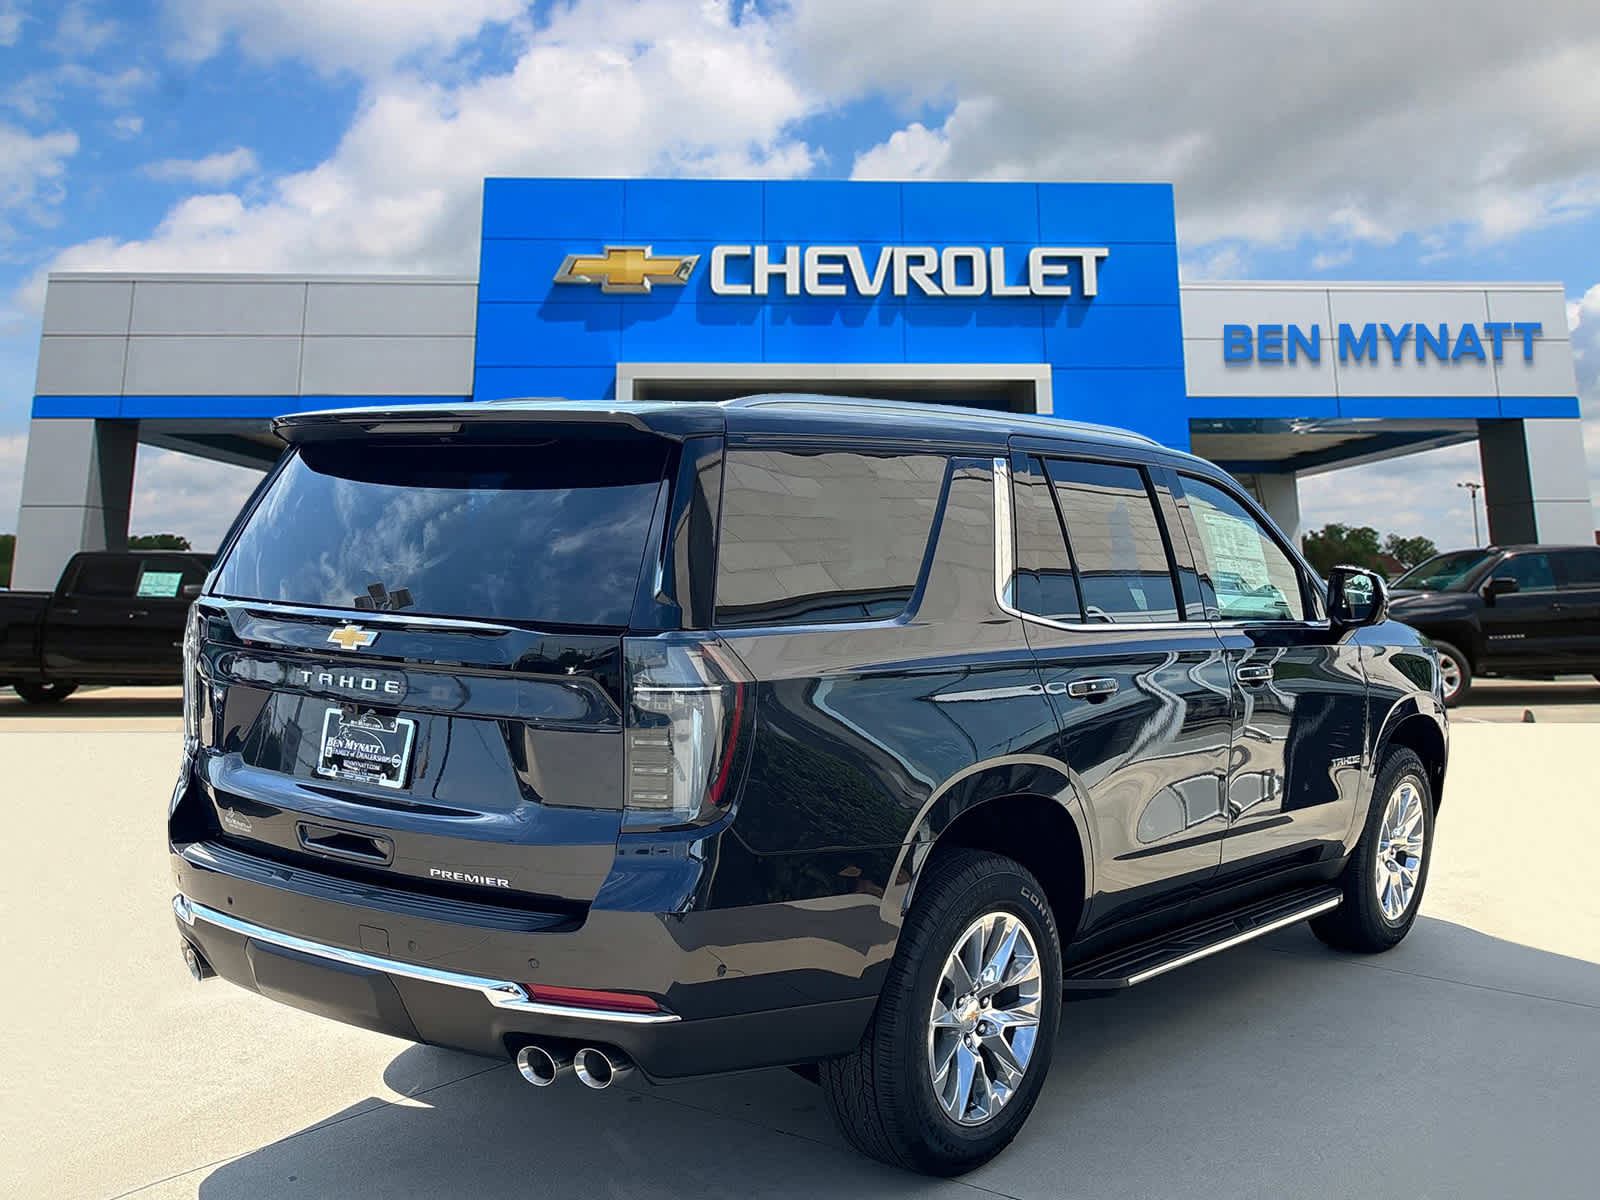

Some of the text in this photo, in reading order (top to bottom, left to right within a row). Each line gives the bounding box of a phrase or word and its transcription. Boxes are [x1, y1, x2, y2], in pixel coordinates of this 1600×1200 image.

[711, 244, 1110, 297] CHEVROLET
[1223, 321, 1542, 363] BEN MYNATT
[300, 670, 400, 694] TAHOE
[327, 736, 381, 754] BEN MYNATT
[1331, 754, 1361, 769] TAHOE
[429, 868, 511, 888] PREMIER
